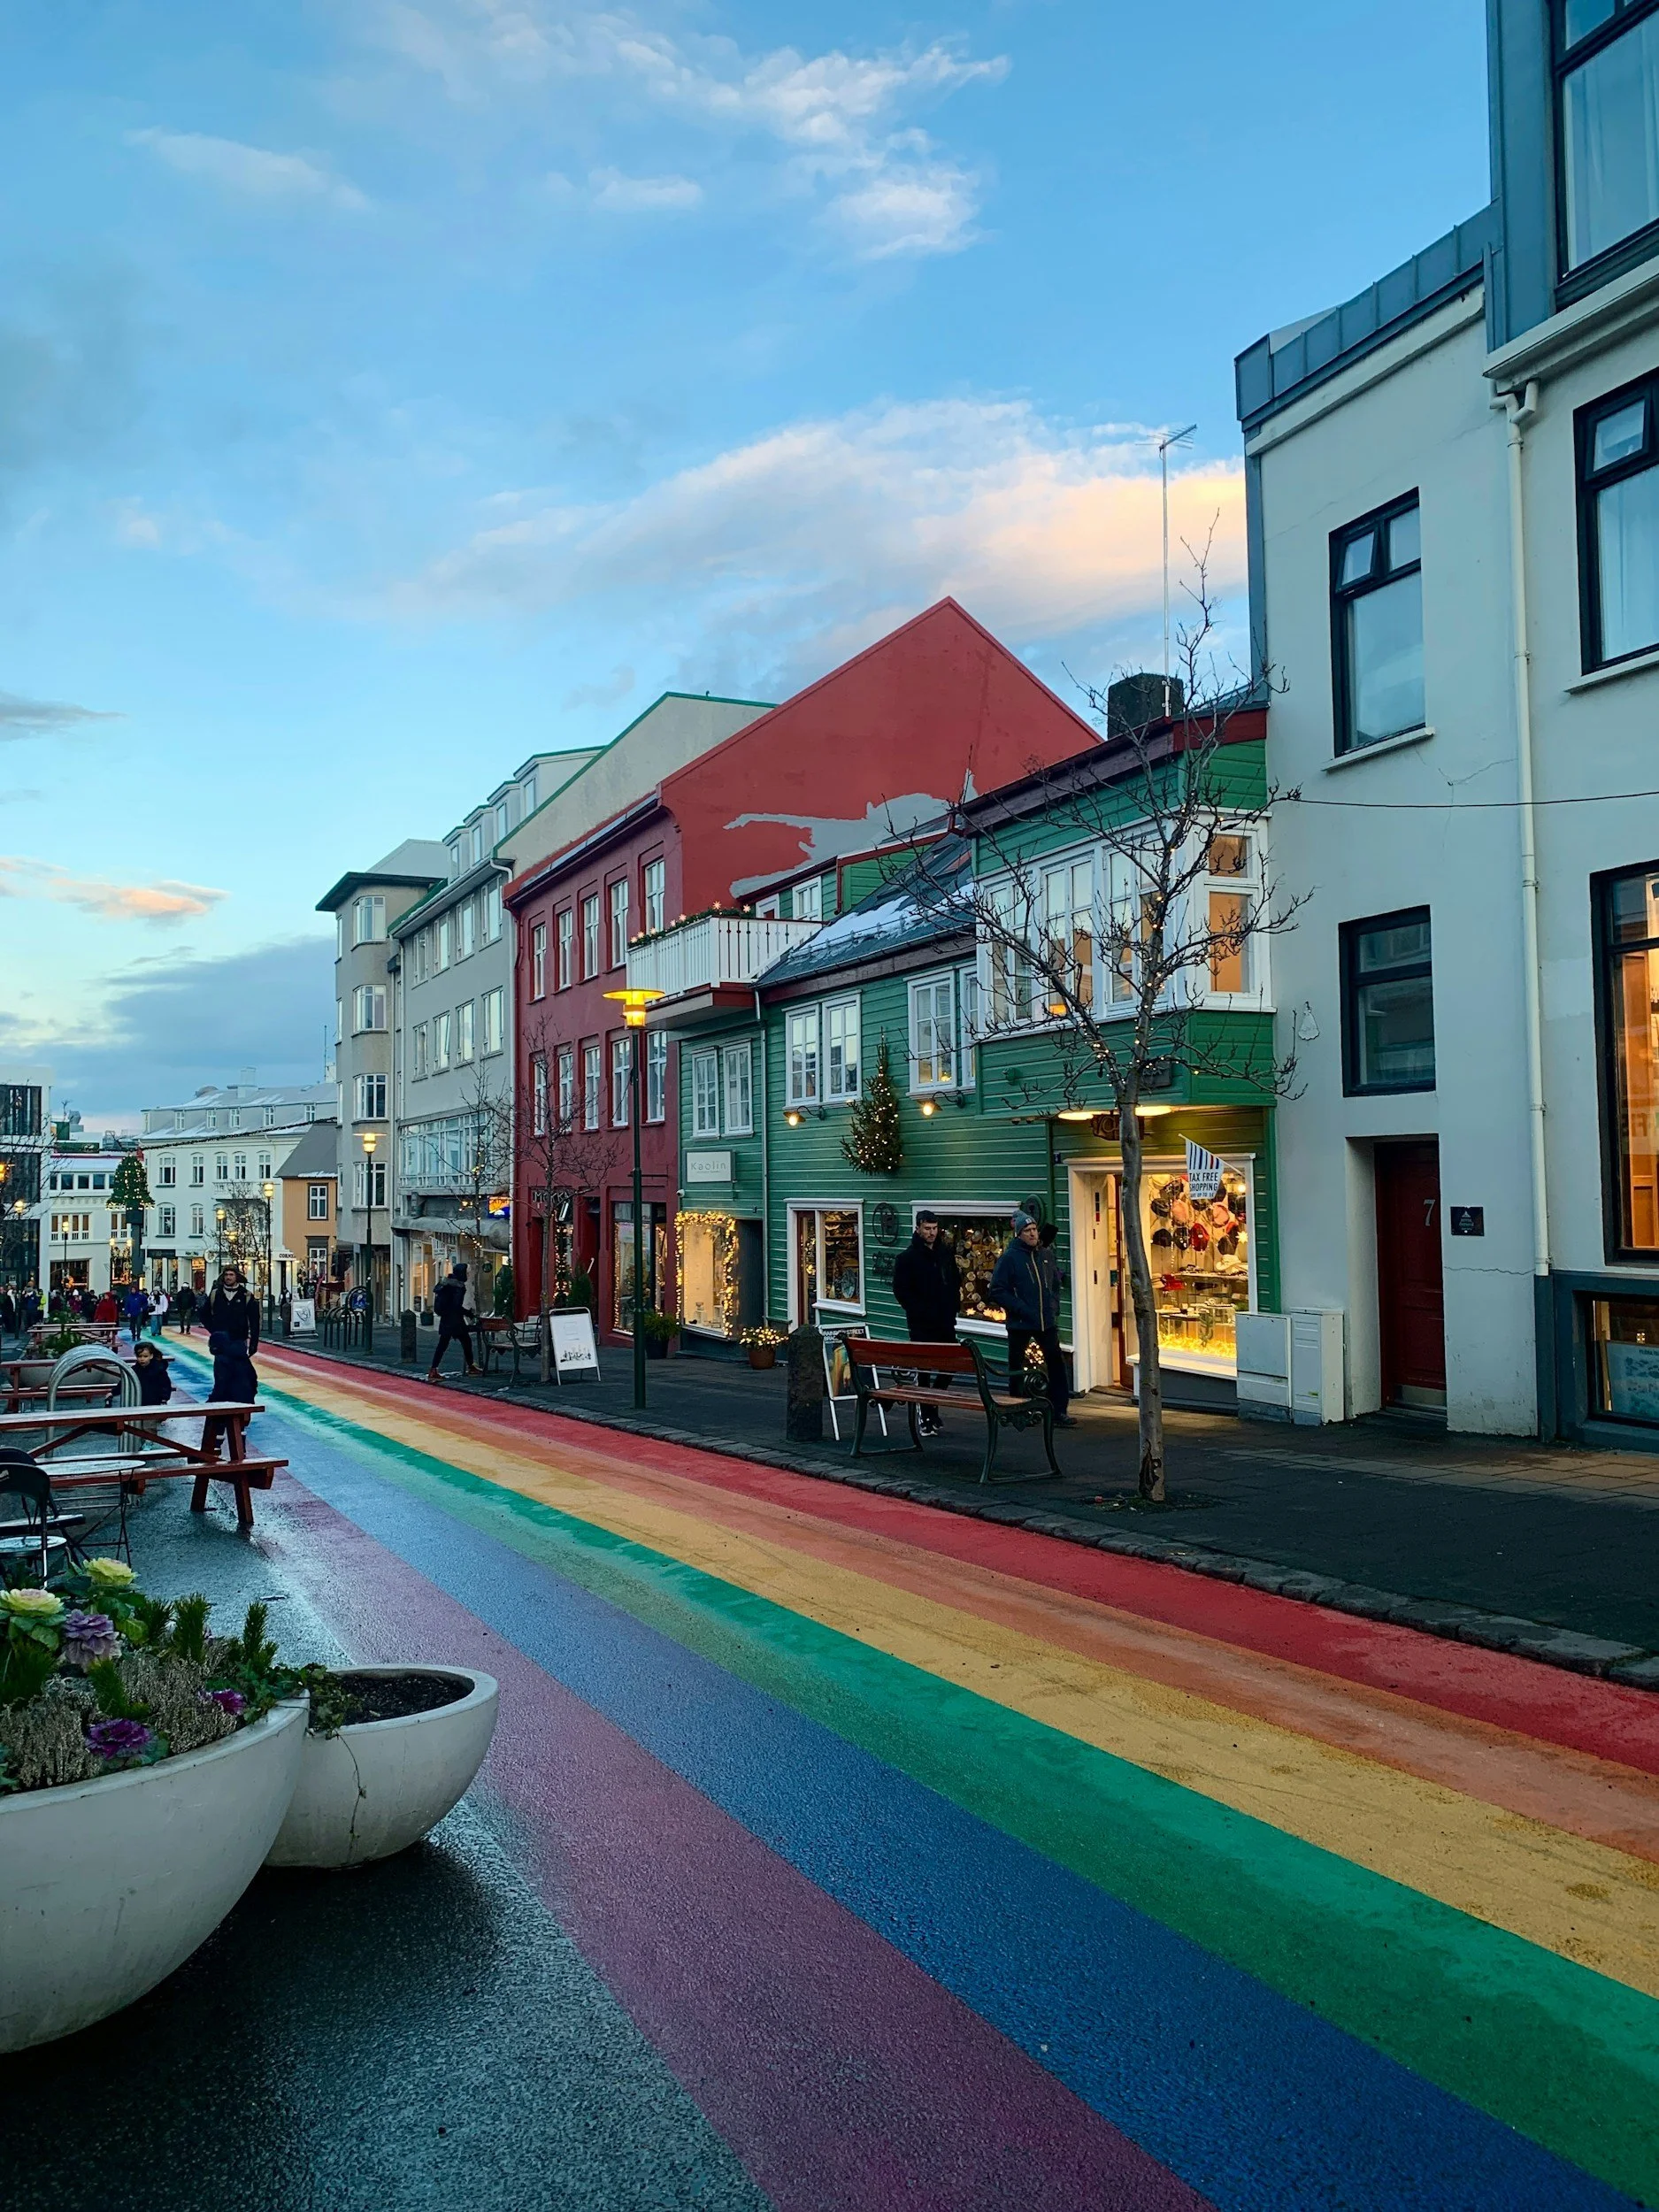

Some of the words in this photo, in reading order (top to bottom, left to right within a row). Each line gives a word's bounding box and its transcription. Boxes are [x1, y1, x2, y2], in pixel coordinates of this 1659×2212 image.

[691, 1161, 726, 1171] Kaolin
[1189, 1172, 1201, 1182] TAX
[1202, 1171, 1218, 1182] FREE
[1189, 1182, 1218, 1192] SHOPPING
[1423, 1199, 1436, 1226] 7
